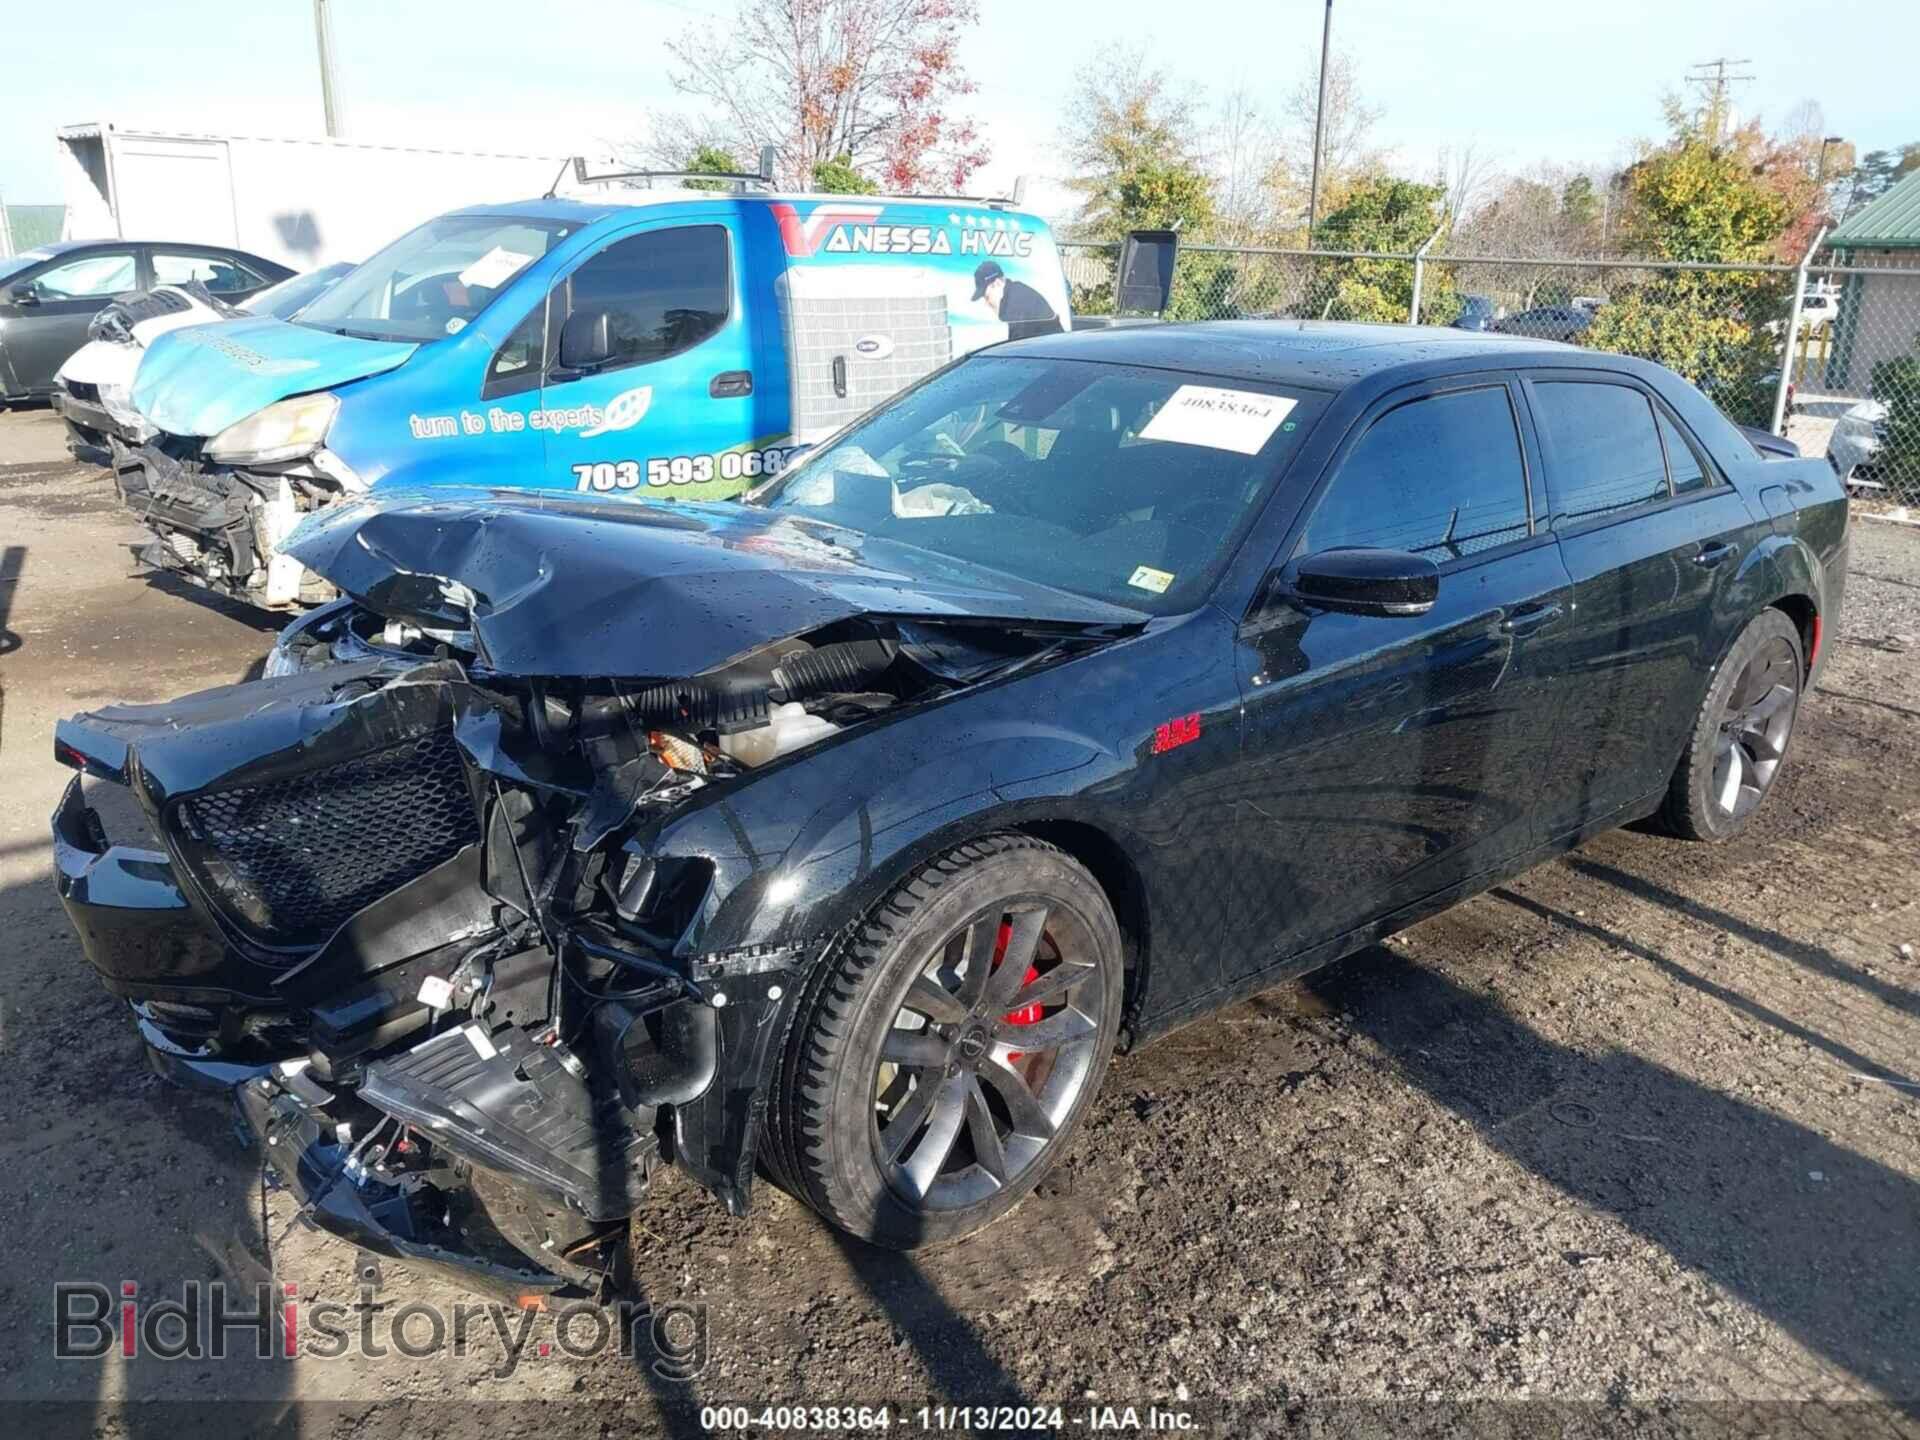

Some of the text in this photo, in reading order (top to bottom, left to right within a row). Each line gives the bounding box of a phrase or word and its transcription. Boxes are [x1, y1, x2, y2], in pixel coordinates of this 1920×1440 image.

[768, 203, 1032, 257] VANESSA HVAC
[410, 403, 604, 438] turn to the experts
[572, 460, 639, 492] 703
[647, 455, 714, 487] 593
